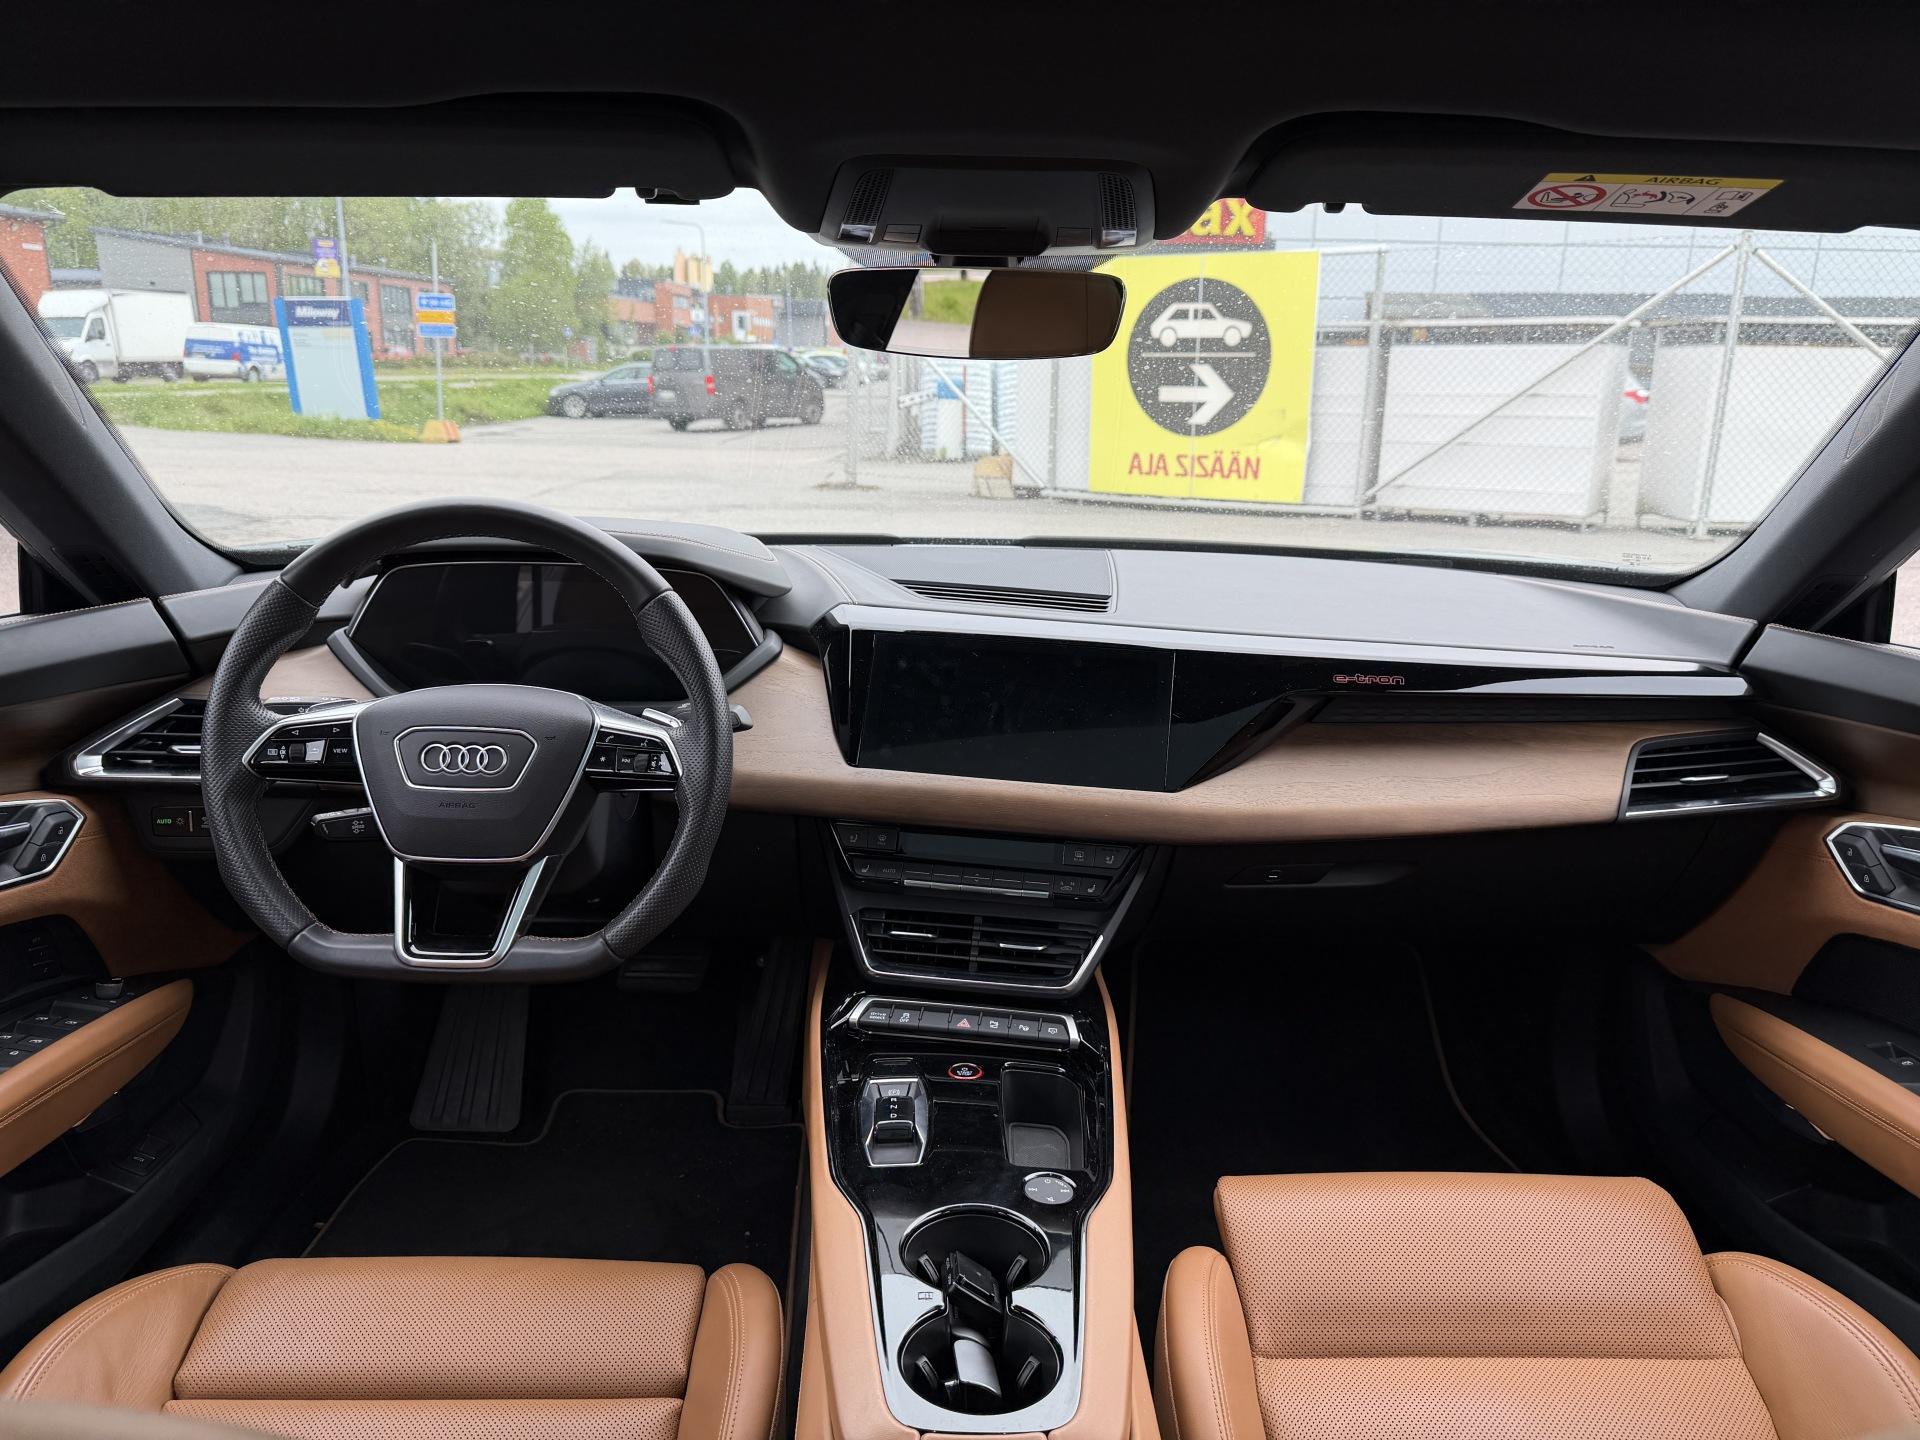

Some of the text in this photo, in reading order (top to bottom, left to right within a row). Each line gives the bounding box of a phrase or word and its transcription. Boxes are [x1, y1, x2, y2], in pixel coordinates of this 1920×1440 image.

[1644, 176, 1722, 186] AIRBAG
[1128, 450, 1261, 480] AJA SISÄÄN
[1332, 673, 1405, 686] e-tron
[438, 801, 476, 809] AIRBAG
